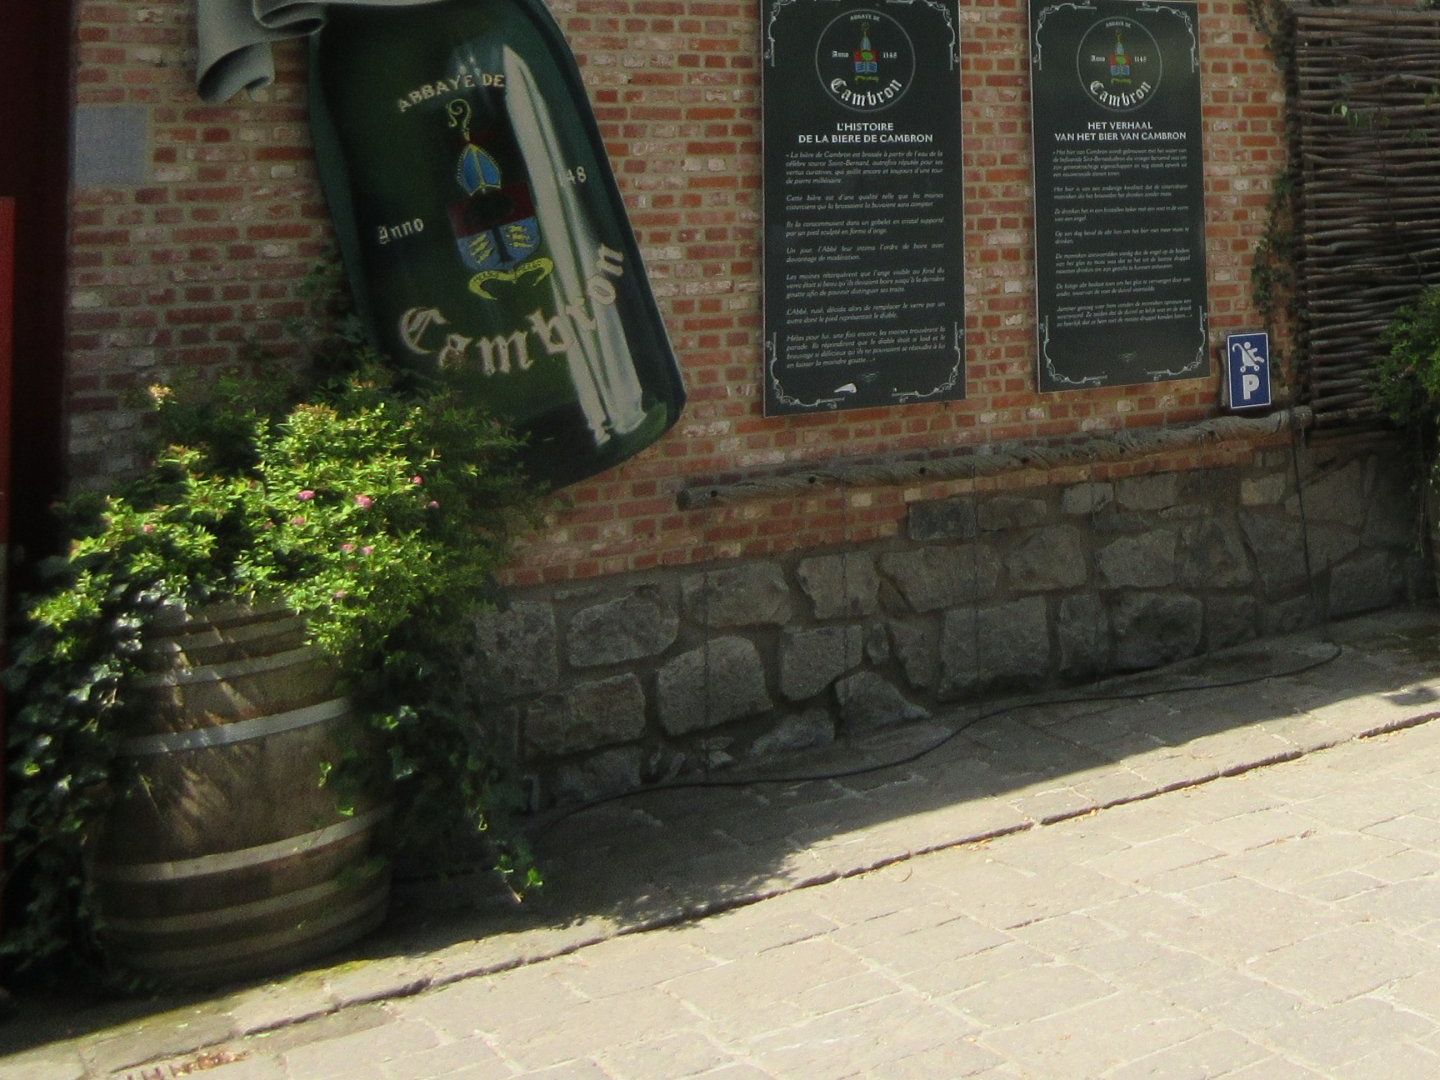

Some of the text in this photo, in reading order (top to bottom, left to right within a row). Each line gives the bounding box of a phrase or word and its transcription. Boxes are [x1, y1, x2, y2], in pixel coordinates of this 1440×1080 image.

[398, 73, 505, 112] ABBAYE DE
[830, 78, 902, 107] Cambron
[1090, 80, 1152, 107] Cambron
[798, 133, 933, 143] DE LA BIERE DE CAMBRON
[836, 122, 894, 131] L'HISTOIRE
[1055, 131, 1186, 141] VAN HET BIER VAN CAMBRON
[1088, 121, 1152, 130] HET VERHAAL
[378, 218, 424, 244] Anno
[399, 243, 624, 376] Cambron
[1242, 374, 1260, 400] P
